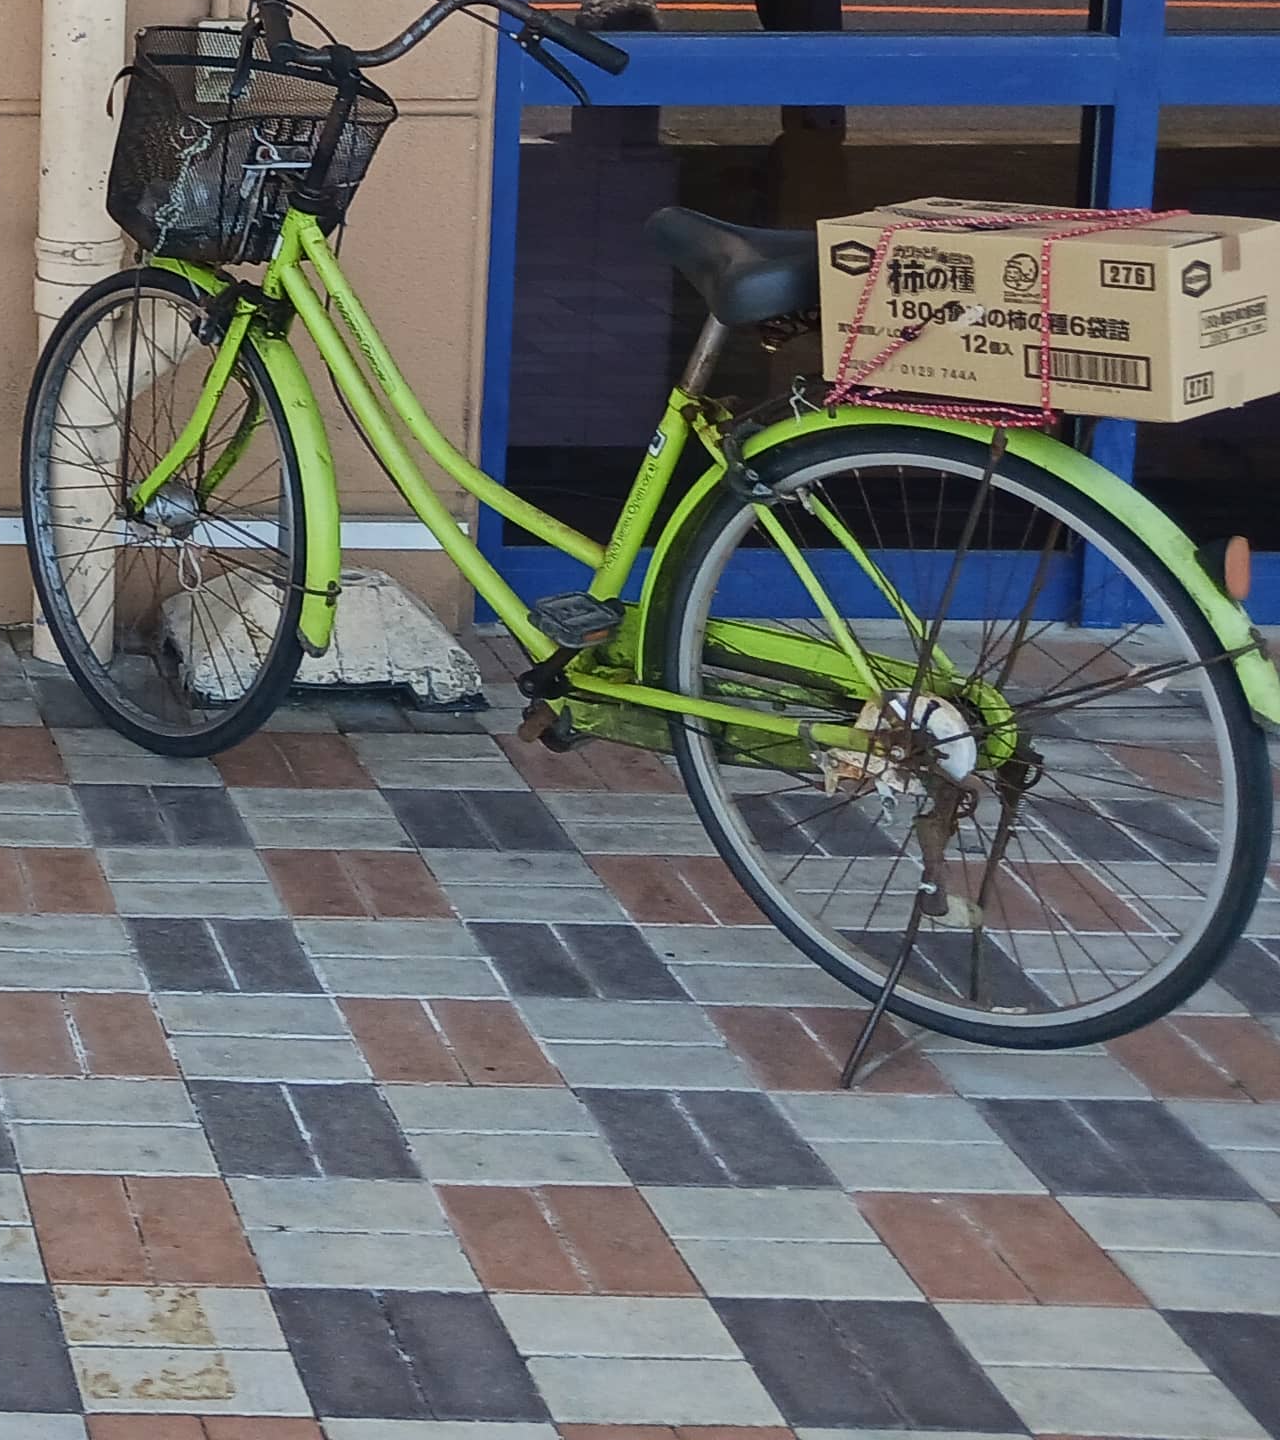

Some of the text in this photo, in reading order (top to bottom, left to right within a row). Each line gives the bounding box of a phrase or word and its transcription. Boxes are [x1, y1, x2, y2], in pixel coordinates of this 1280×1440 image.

[887, 259, 976, 296] 柿の種
[1109, 265, 1145, 286] 276
